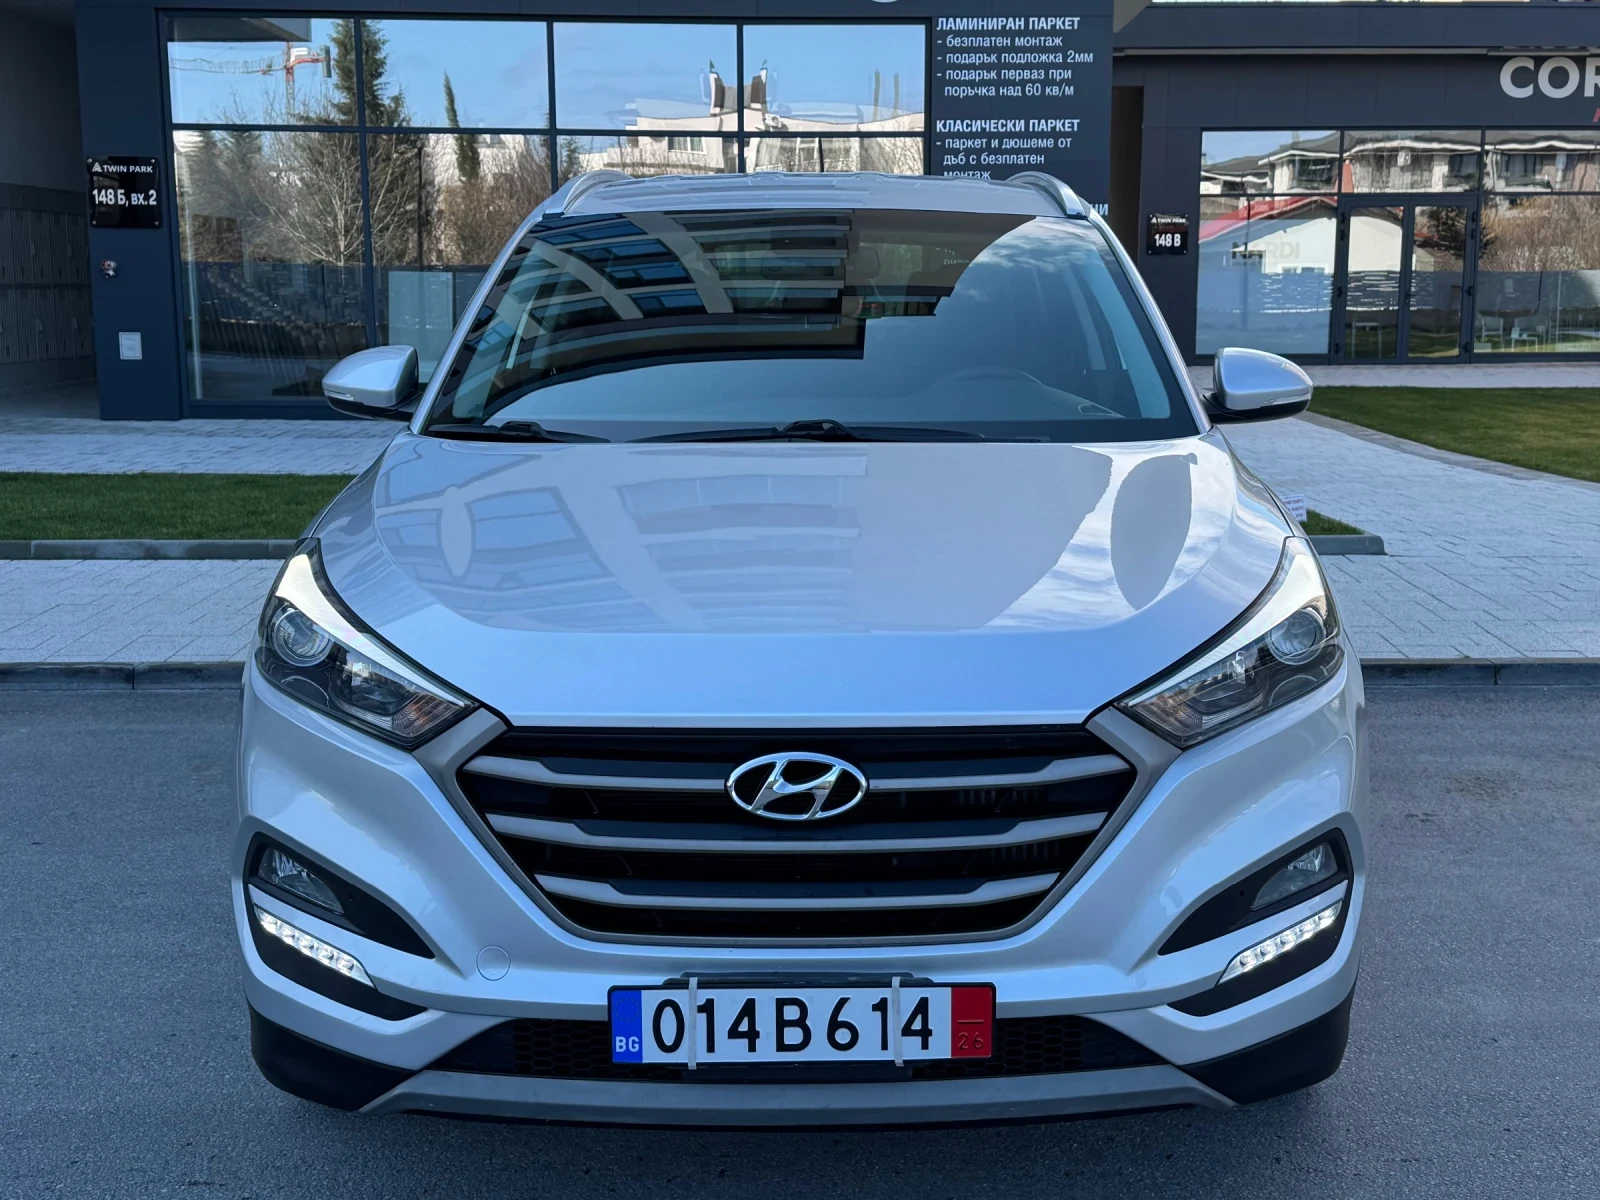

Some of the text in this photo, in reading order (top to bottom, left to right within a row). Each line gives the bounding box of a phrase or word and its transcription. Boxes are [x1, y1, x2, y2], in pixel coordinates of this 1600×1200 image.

[936, 17, 1081, 31] ЛАМИНИРАН ПАРКЕТ
[946, 34, 1011, 47] безплатен
[1014, 36, 1063, 47] монтаж
[946, 53, 998, 66] подарък
[1001, 52, 1063, 64] подложка
[1066, 50, 1094, 63] 2мм
[946, 70, 998, 82] подарък
[1001, 70, 1045, 82] перваз
[1049, 69, 1072, 82] при
[944, 83, 1075, 98] поръчка над 60 кв/м
[936, 119, 1081, 133] КЛАСИЧЕСКИ ПАРКЕТ
[945, 138, 988, 151] паркет
[991, 138, 999, 149] и
[1001, 138, 1055, 150] дюшеме
[1058, 138, 1072, 148] от
[943, 152, 1045, 166] дъб с безплатен
[103, 165, 153, 173] TWIN PARK
[92, 188, 116, 205] 148
[1154, 233, 1173, 247] 148
[615, 1036, 640, 1053] BG
[958, 1032, 984, 1049] 26
